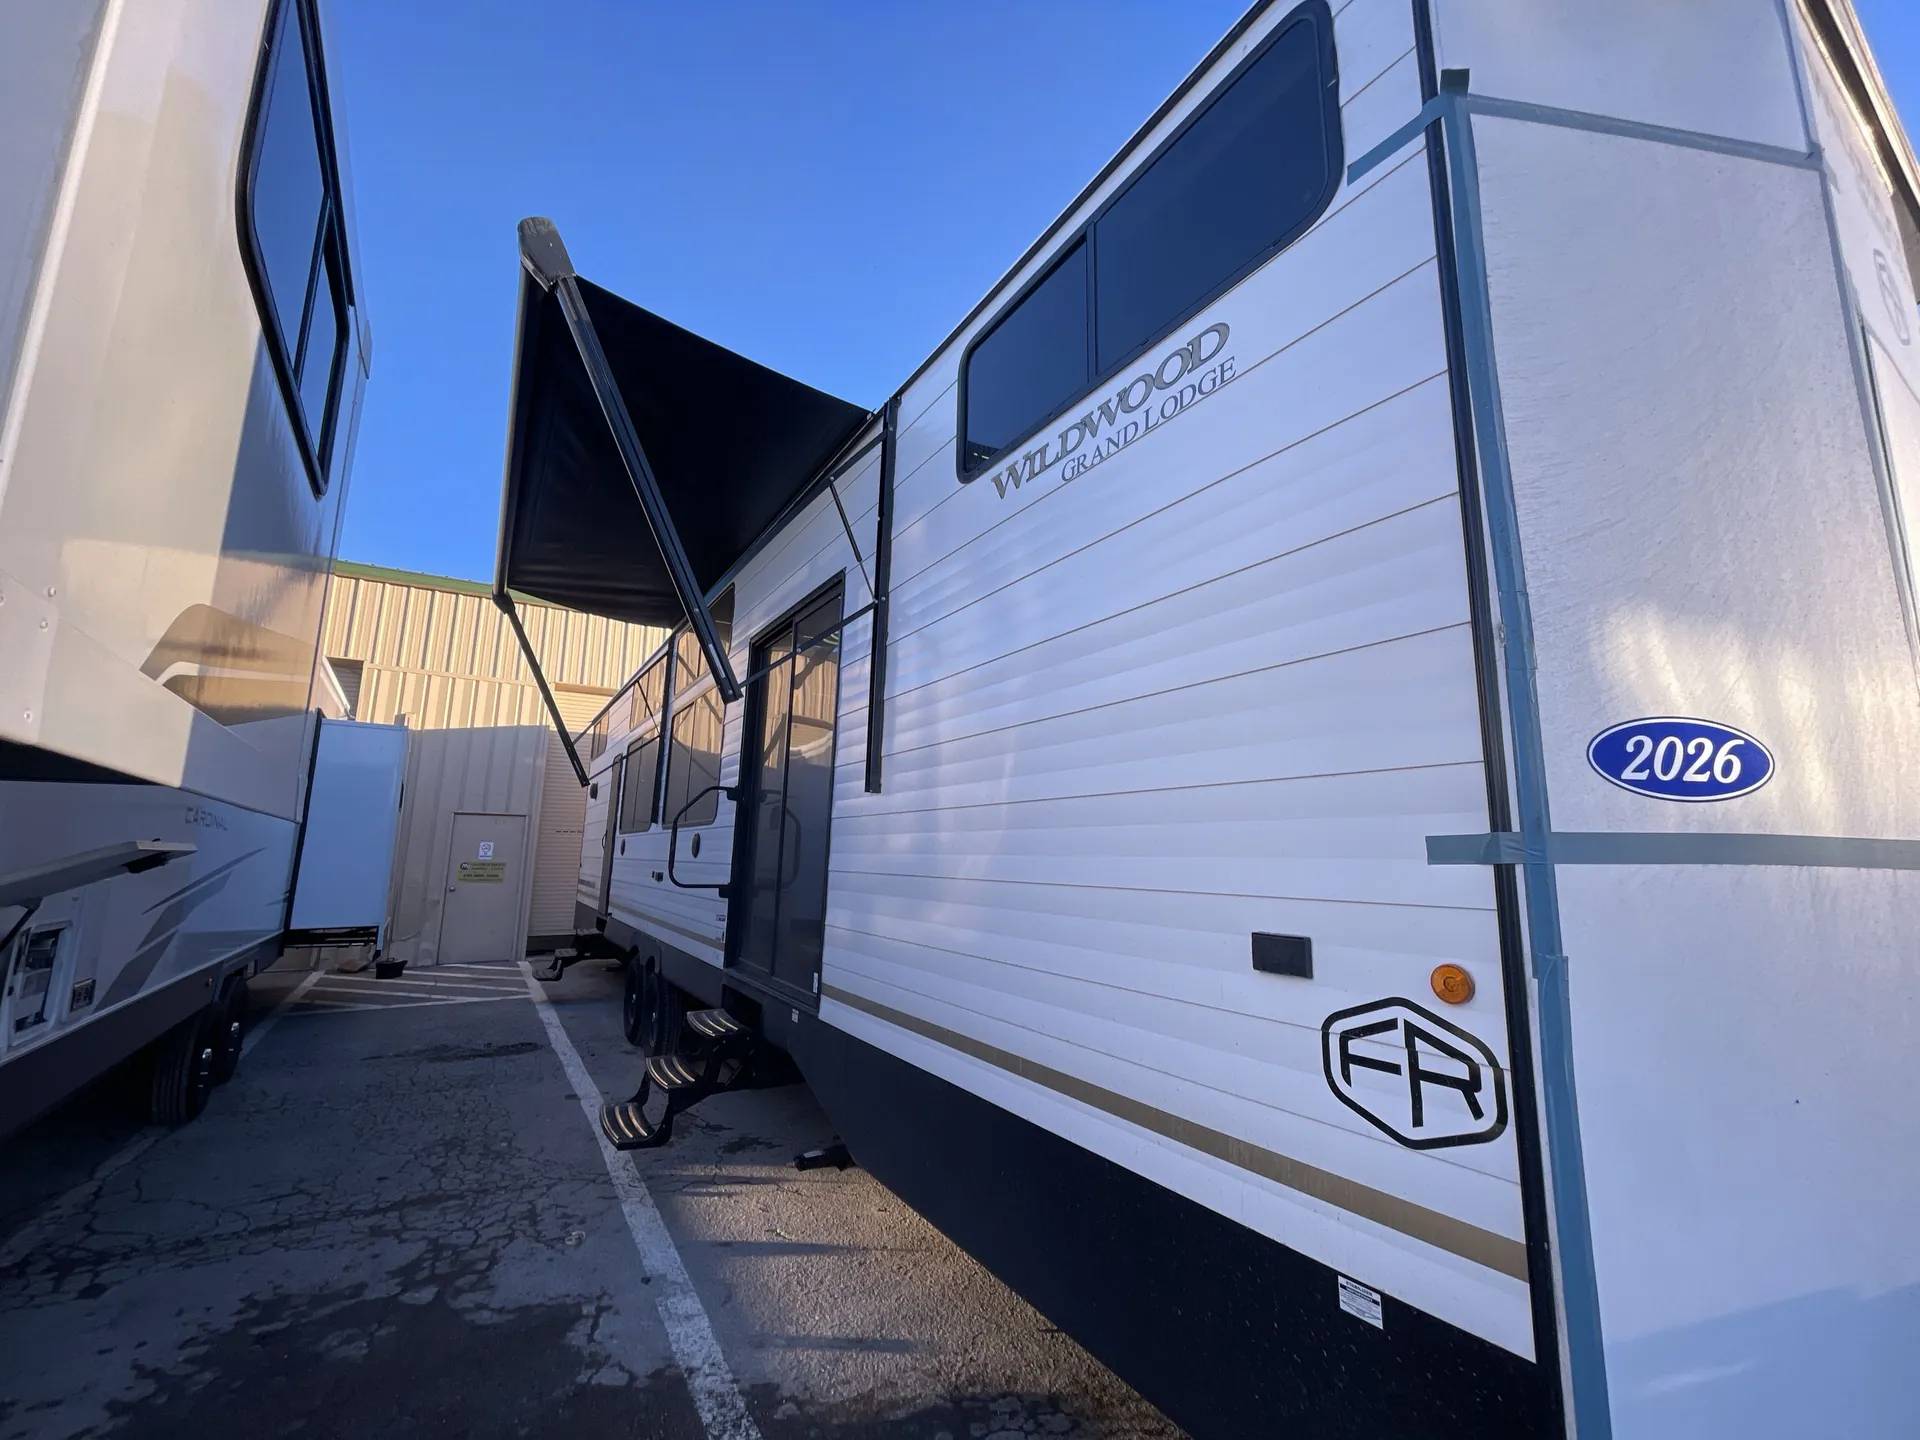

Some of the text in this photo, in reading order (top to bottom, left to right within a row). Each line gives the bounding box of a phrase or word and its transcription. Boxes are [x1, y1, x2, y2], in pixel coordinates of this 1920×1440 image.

[991, 322, 1230, 500] WILDWOOD
[1061, 356, 1237, 482] GRAND LODGE
[1620, 735, 1745, 784] 2026
[1339, 1017, 1485, 1128] FR
